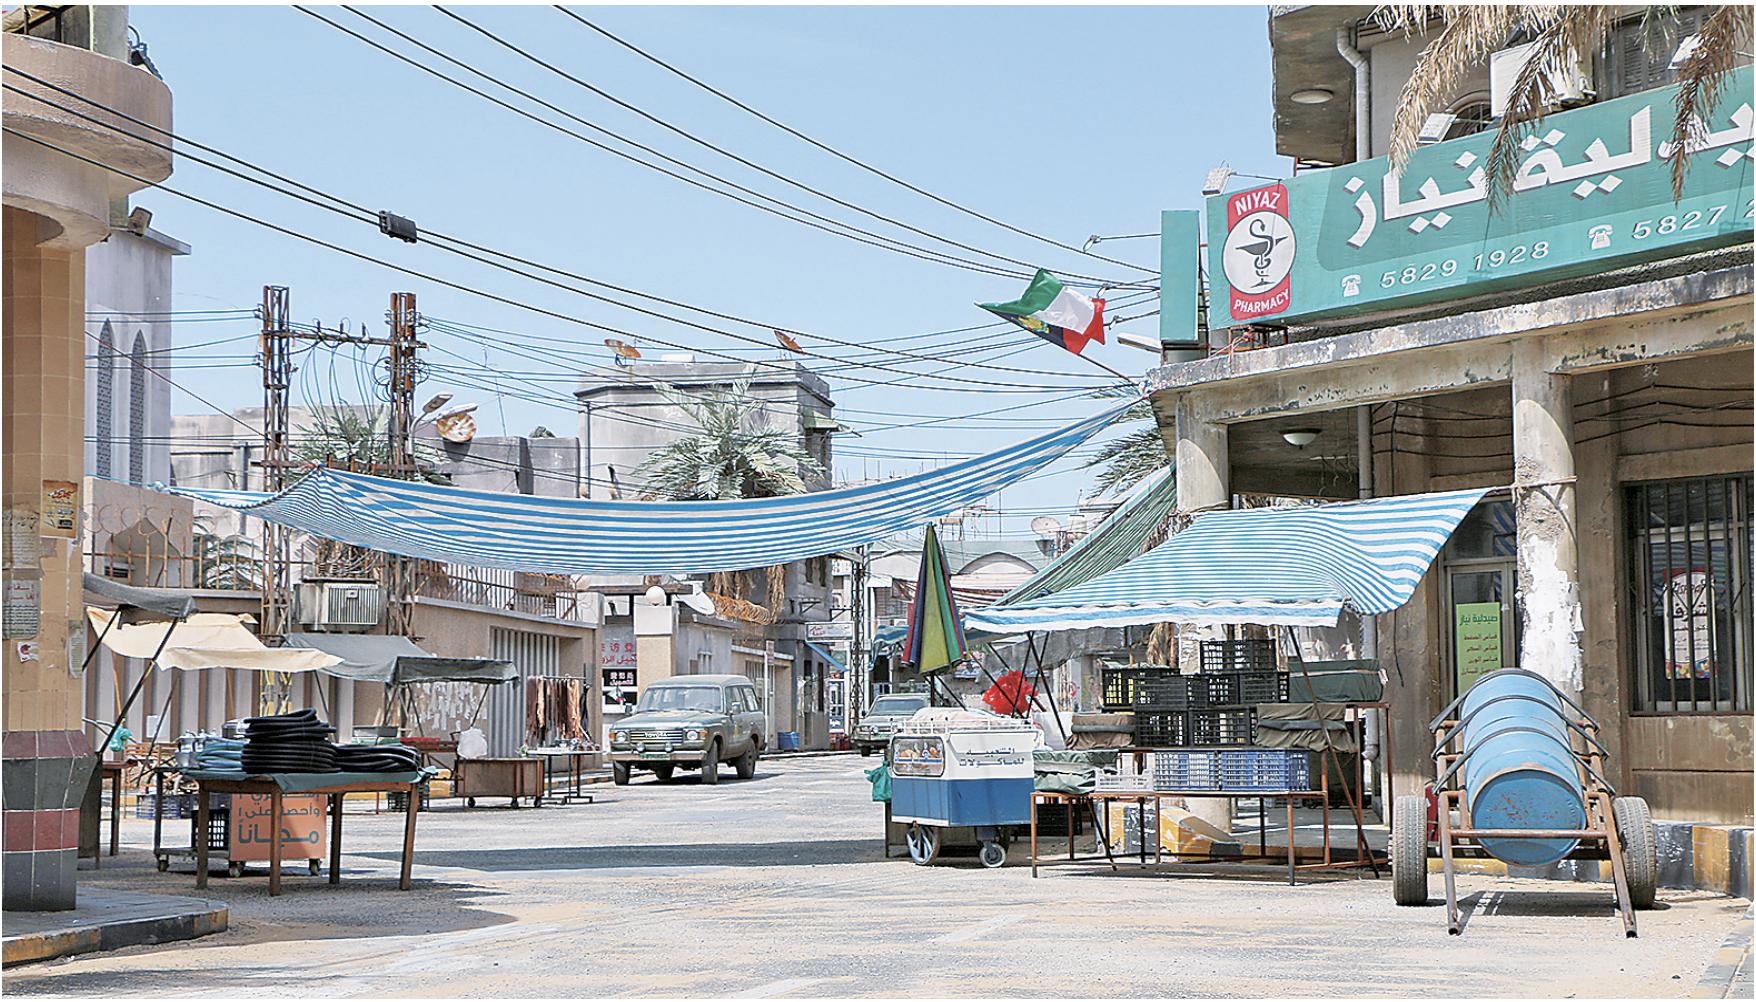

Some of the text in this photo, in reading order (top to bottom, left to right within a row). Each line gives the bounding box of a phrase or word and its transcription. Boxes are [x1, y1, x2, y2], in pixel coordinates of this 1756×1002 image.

[1235, 191, 1280, 216] NIYAZ
[1344, 151, 1489, 247] نياز
[1631, 205, 1728, 240] 5827
[1378, 241, 1549, 289] 5829 1928
[1233, 288, 1290, 313] PHARMACY
[1472, 613, 1498, 625] صيدلية
